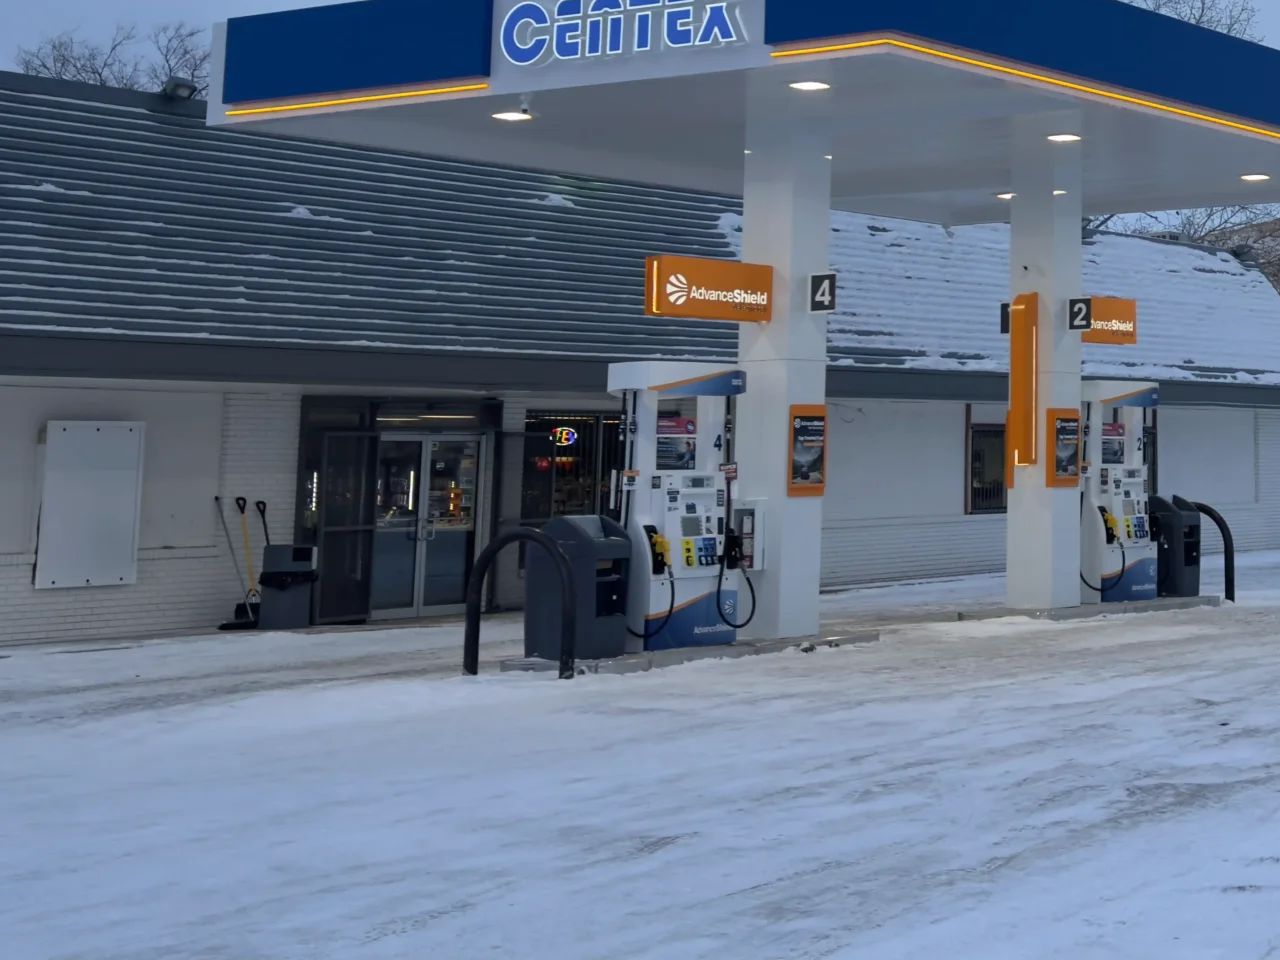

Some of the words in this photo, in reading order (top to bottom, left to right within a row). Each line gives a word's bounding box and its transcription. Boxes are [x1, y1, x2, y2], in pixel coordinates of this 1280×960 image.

[690, 285, 768, 305] AdvanceShield
[814, 279, 832, 306] 4
[1072, 302, 1087, 327] 2
[713, 434, 723, 452] 4
[1136, 437, 1143, 452] 2
